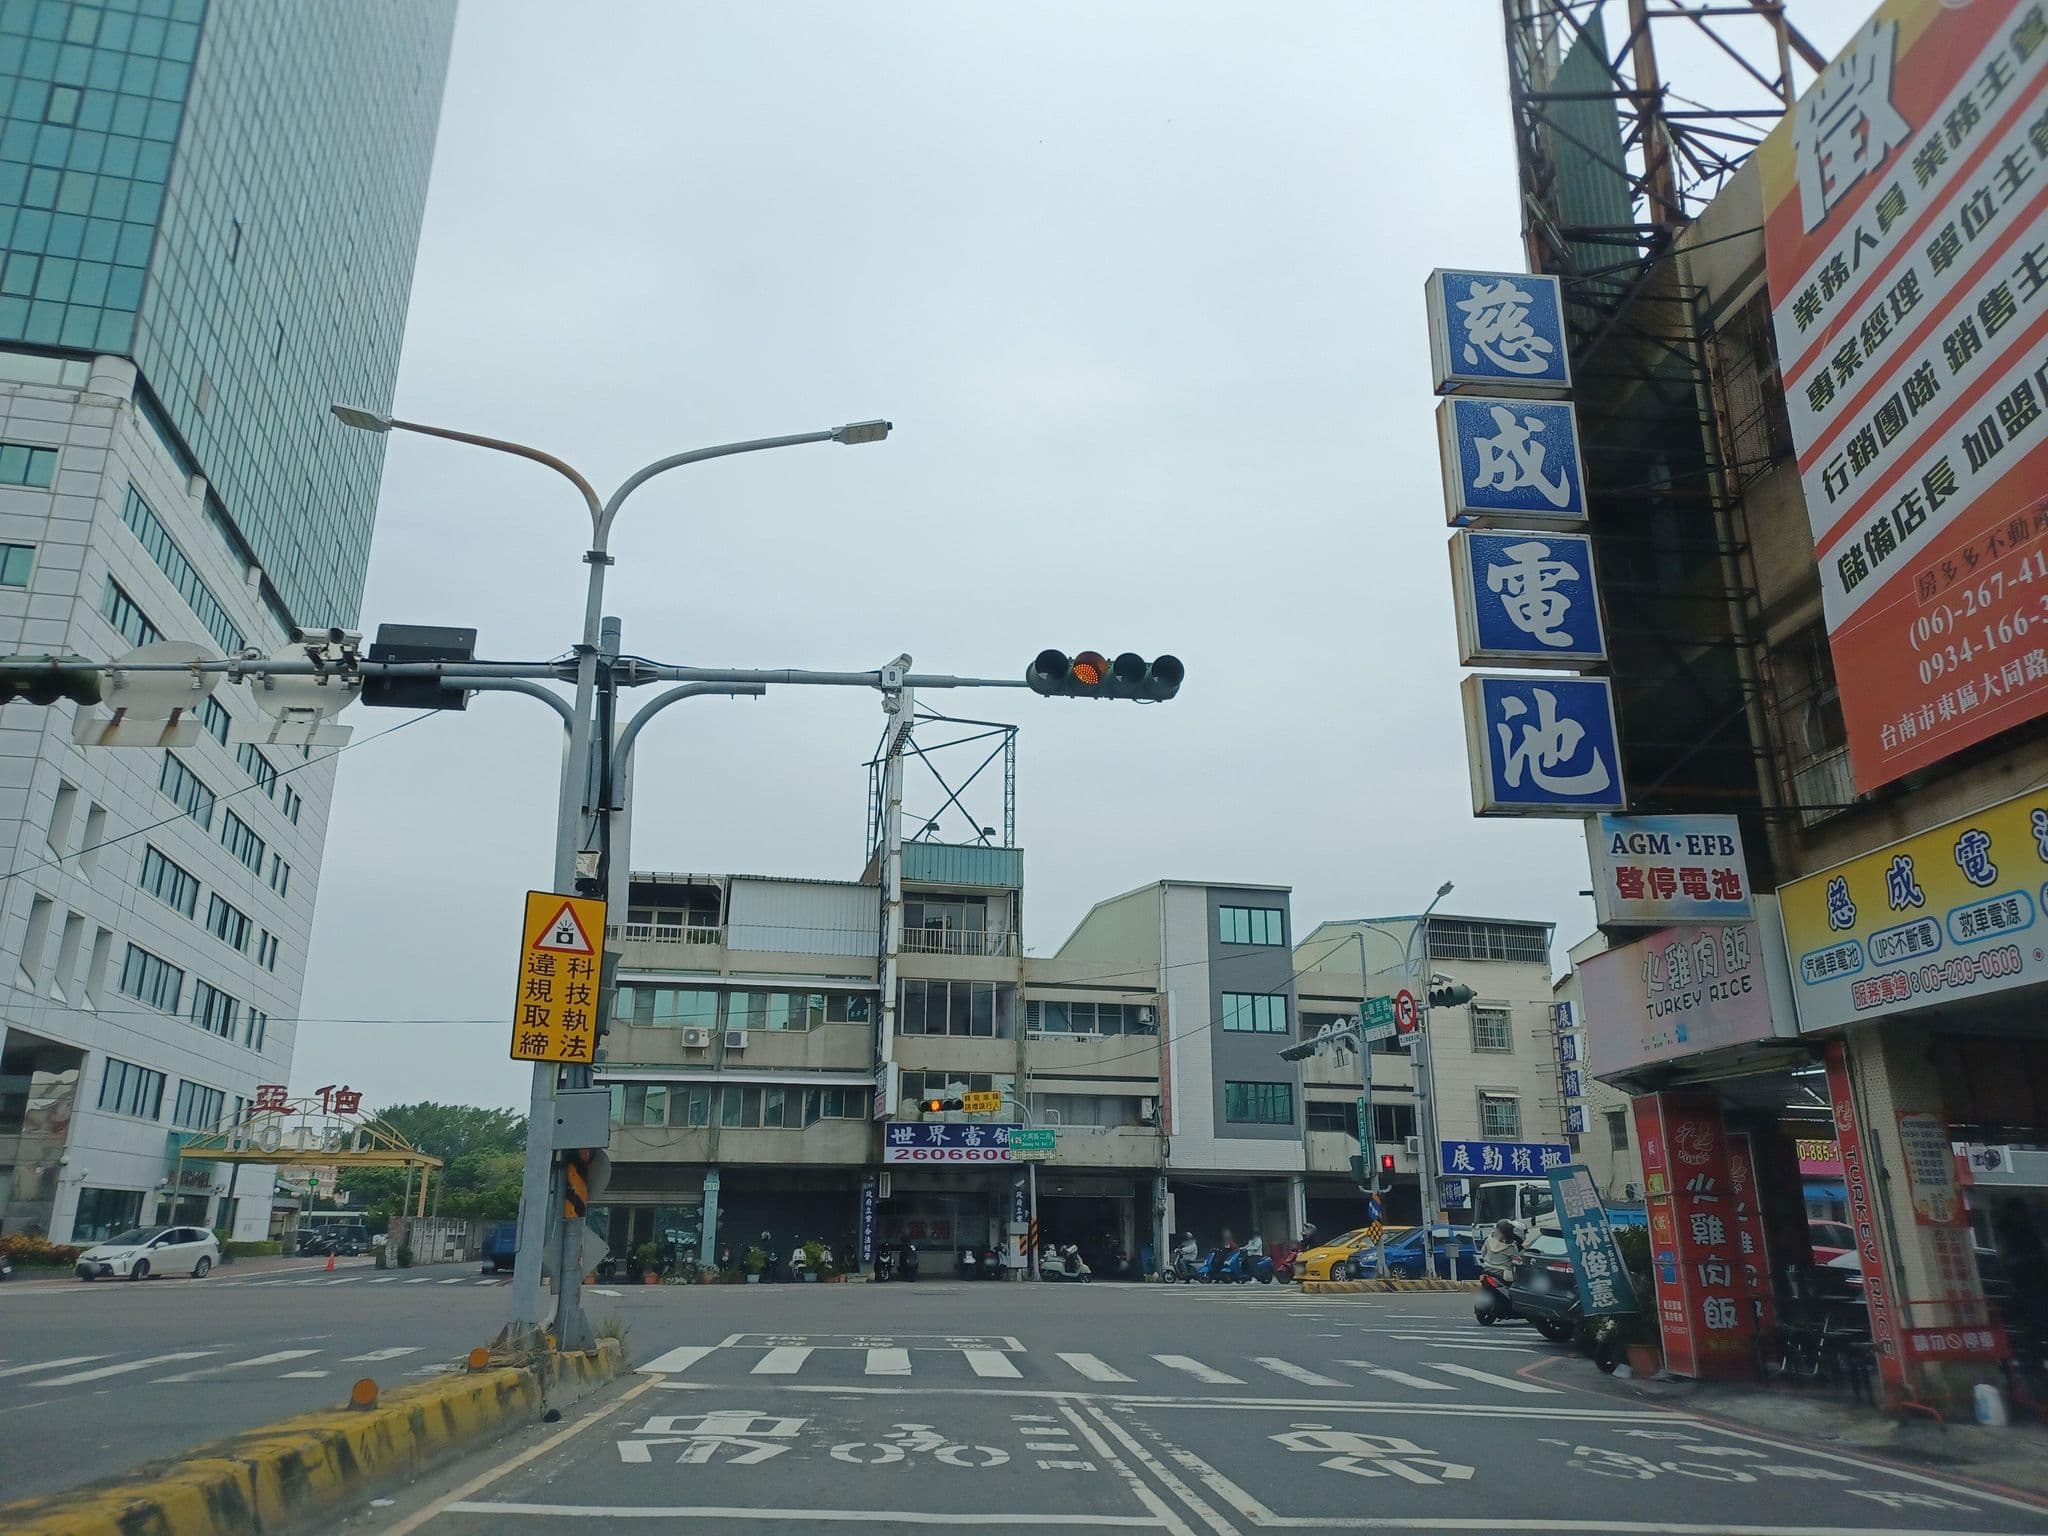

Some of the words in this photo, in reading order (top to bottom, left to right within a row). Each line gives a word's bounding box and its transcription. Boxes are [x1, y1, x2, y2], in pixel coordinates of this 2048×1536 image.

[1792, 181, 1908, 333] 業務人員
[1806, 267, 1924, 412] 專案經理
[1822, 359, 1941, 504] 行銷團隊
[1457, 281, 1611, 795] 慈成電池
[1837, 455, 1960, 594] 儲備店長
[1881, 649, 2048, 751] 台南市東區大同路
[519, 952, 557, 1056] 違規取締
[560, 957, 595, 1058] 科技執法
[1641, 925, 1751, 998] 火雞肉飯
[1646, 991, 1702, 1020] TURKEY
[1710, 975, 1753, 1003] RICE
[224, 1125, 372, 1155] HOTEL
[1686, 1172, 1738, 1329] 火雞肉飯
[1844, 1146, 1877, 1264] TURKEY
